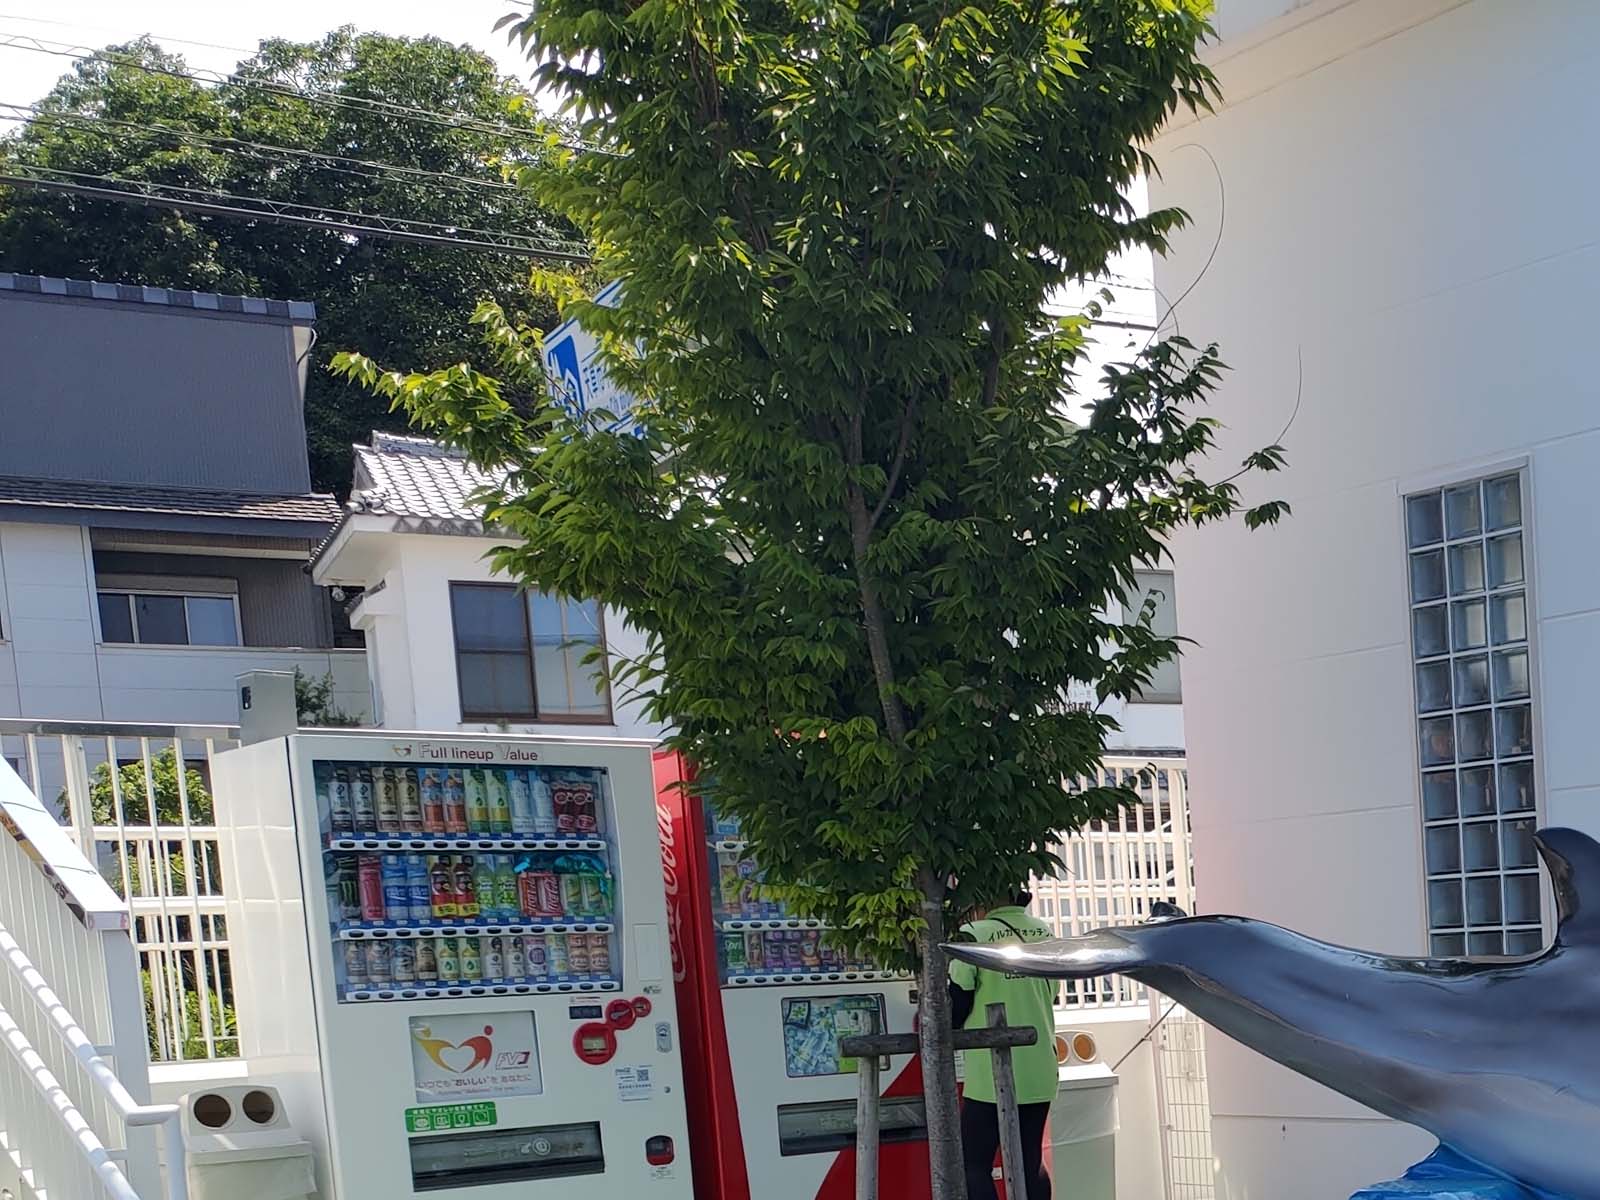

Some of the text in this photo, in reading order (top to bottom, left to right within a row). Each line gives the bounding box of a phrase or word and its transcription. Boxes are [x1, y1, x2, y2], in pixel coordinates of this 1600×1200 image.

[418, 742, 538, 762] Full lineup Value
